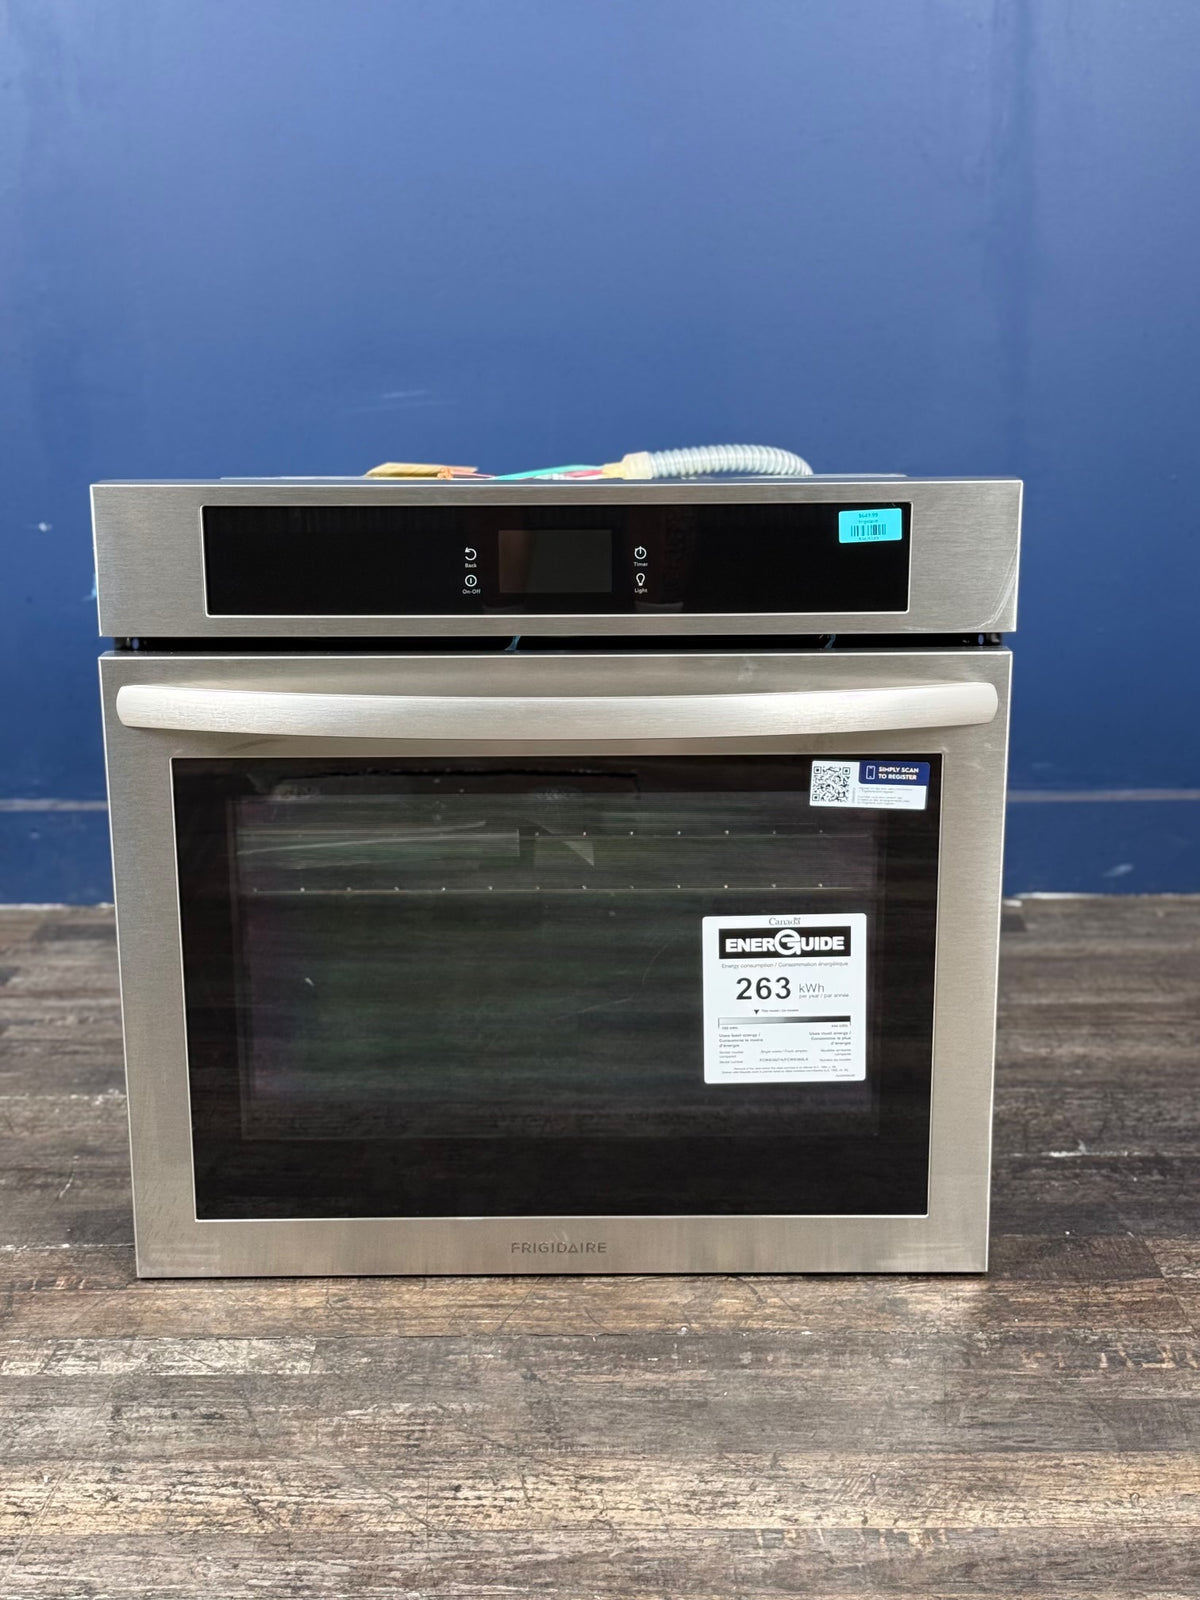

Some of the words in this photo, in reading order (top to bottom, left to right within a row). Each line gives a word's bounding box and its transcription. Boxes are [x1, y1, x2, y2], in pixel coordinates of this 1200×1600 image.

[768, 917, 801, 926] Canada
[725, 929, 845, 956] ENERGUIDE
[736, 976, 791, 1000] 263
[799, 983, 825, 993] kWh
[511, 1242, 607, 1254] FRIGIDAIRE
